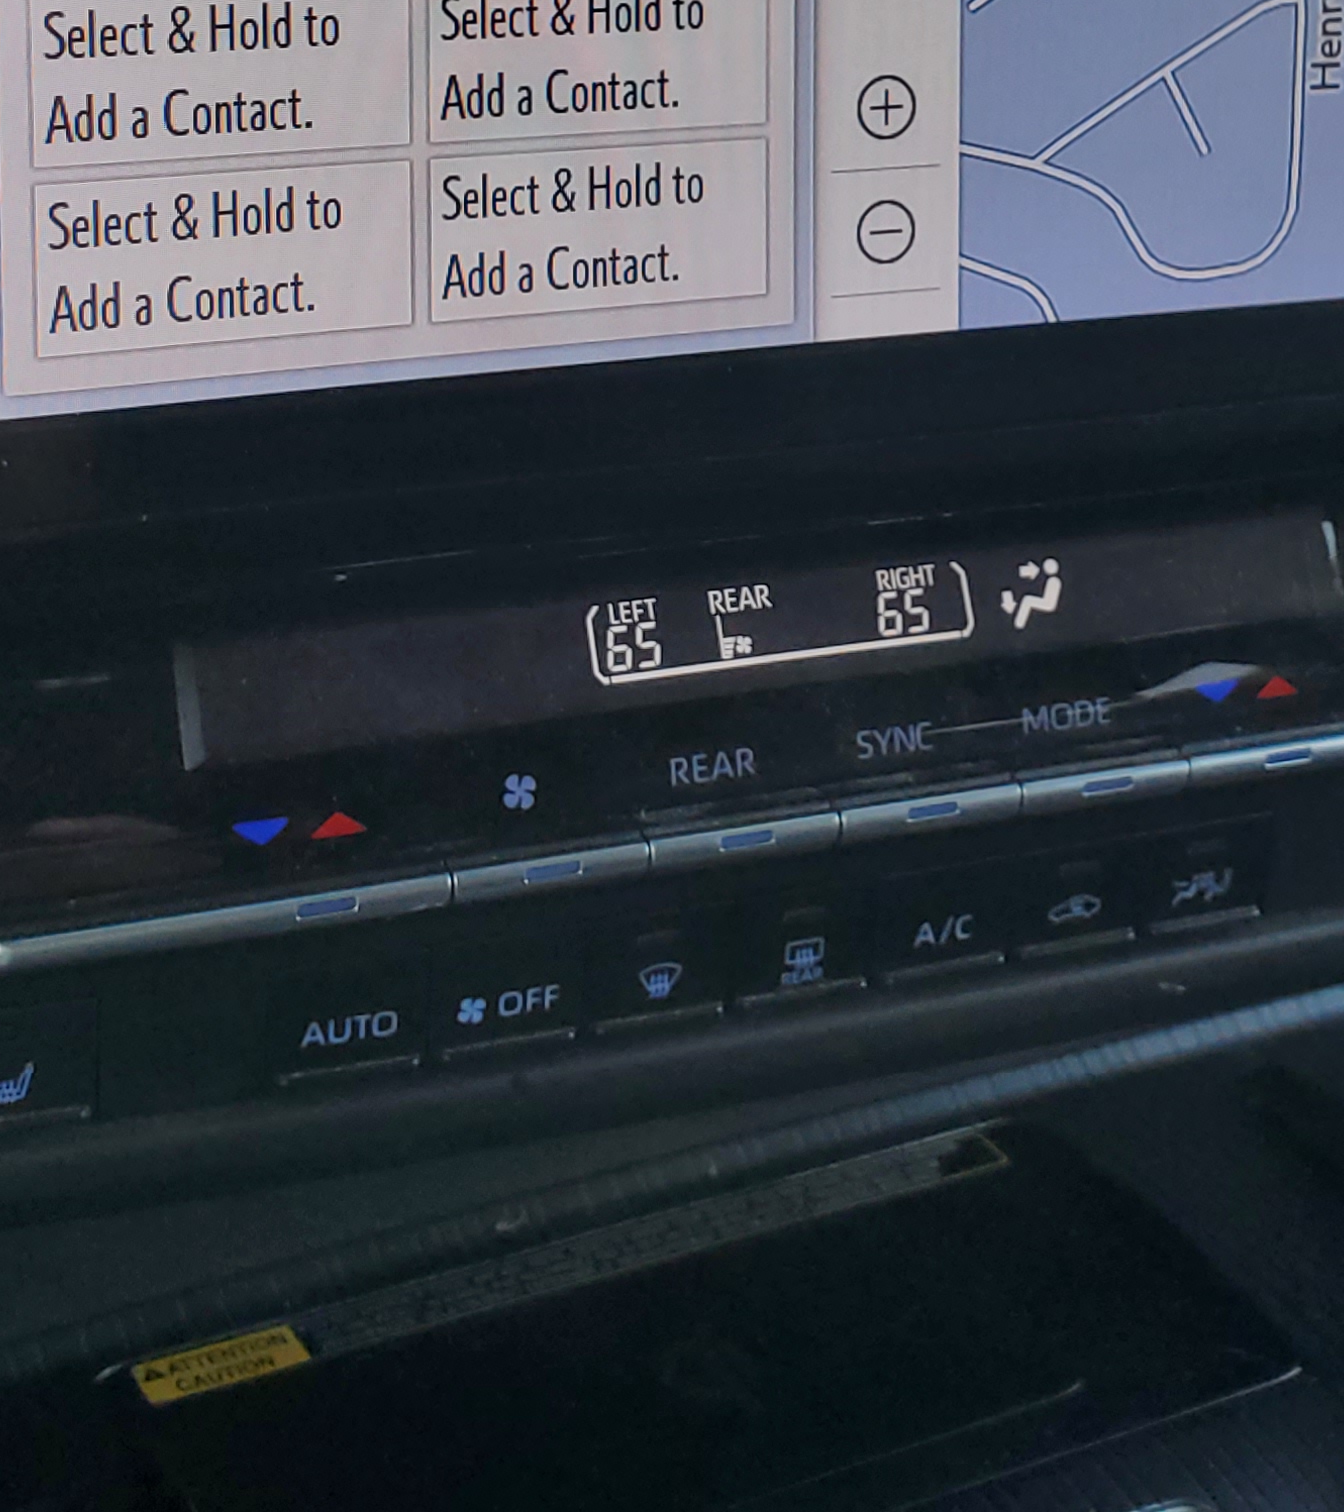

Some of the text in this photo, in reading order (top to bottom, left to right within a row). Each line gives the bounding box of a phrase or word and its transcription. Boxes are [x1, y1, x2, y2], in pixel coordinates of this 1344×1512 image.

[43, 0, 341, 60] Select & Hold to
[440, 69, 679, 122] Add a Contact.
[44, 89, 314, 145] Add a Contact.
[441, 163, 704, 222] Select & Hold to
[47, 186, 343, 251] Select & Hold to
[441, 244, 680, 301] Add a Contact.
[48, 273, 316, 335] Add a Contact.
[875, 564, 936, 592] RIGHT
[607, 598, 658, 625] LEFT
[708, 584, 773, 615] REAR
[877, 588, 930, 638] 65
[606, 622, 662, 673] 65
[1021, 697, 1112, 736] MODE
[856, 721, 933, 760] SYNC
[670, 746, 755, 787] REAR
[913, 914, 973, 949] A/C
[497, 984, 561, 1017] OFF
[301, 1010, 398, 1048] AUTO
[169, 1333, 288, 1375] ATTENTION
[175, 1354, 275, 1391] CAUTION
